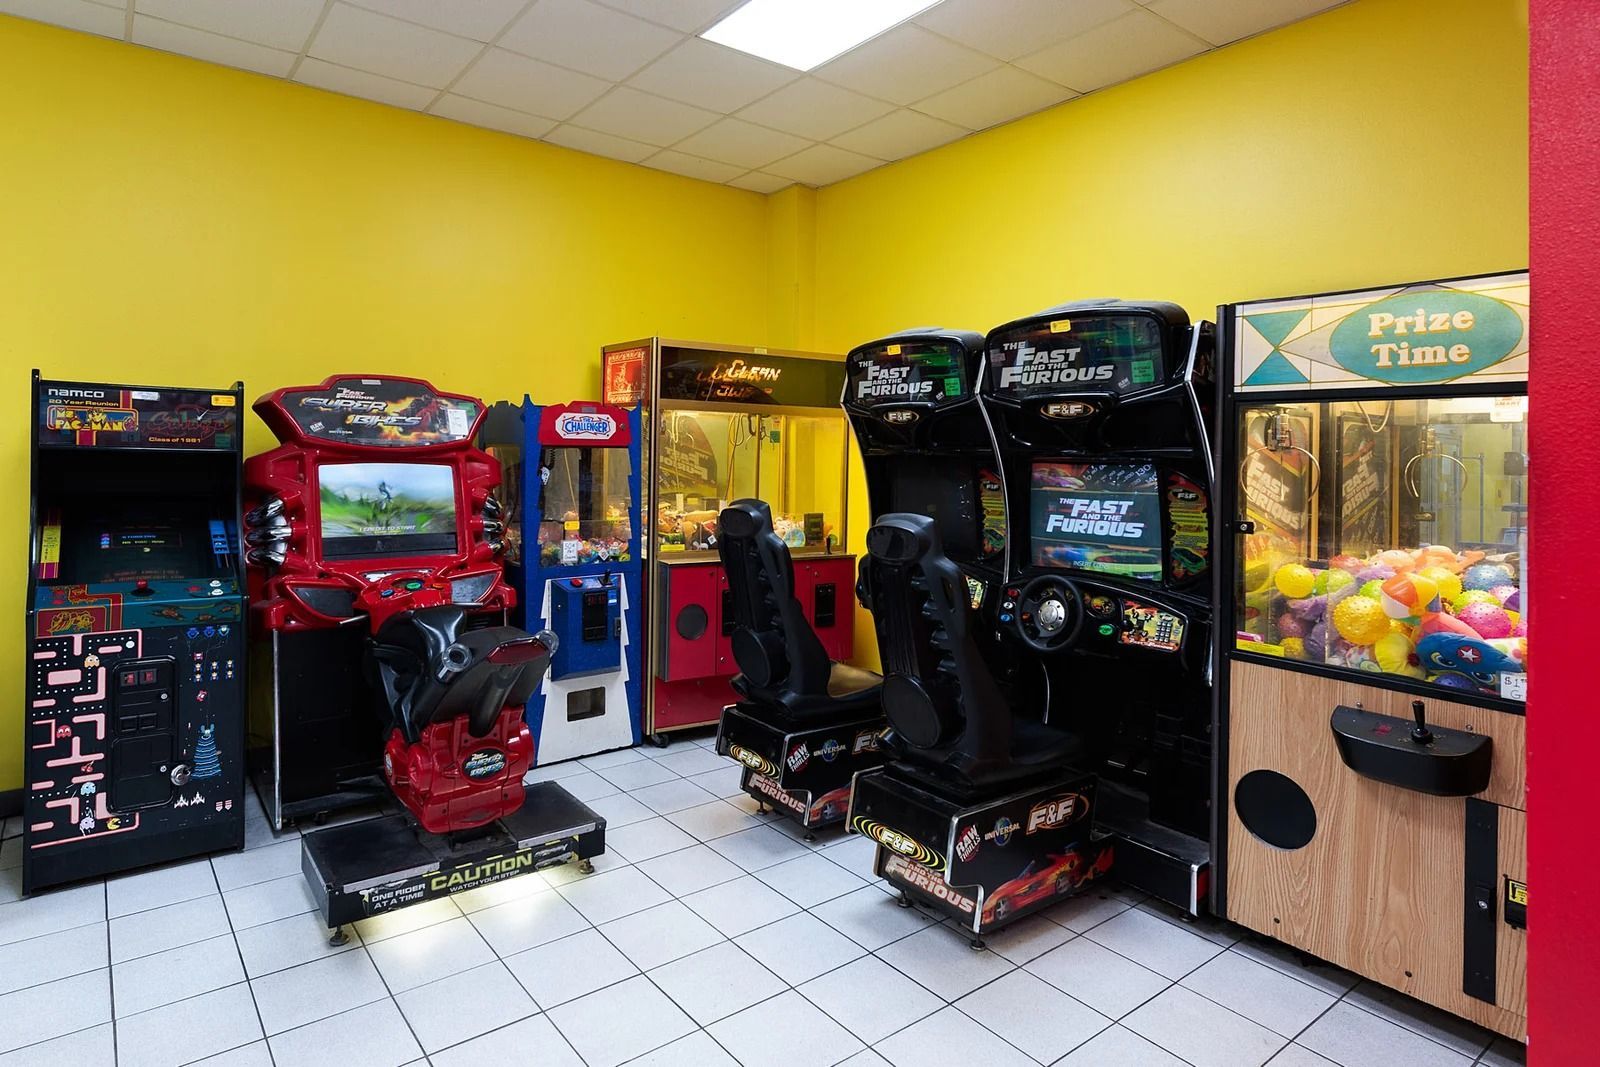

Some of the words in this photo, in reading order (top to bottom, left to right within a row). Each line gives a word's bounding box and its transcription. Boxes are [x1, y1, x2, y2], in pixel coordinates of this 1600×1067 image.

[1368, 308, 1475, 338] Prize
[1003, 341, 1026, 350] THE
[1370, 341, 1471, 369] Time
[859, 360, 874, 368] THE
[1016, 347, 1081, 365] FAST
[727, 359, 781, 381] CLEAN
[867, 365, 910, 380] FAST
[1024, 364, 1045, 372] AND
[1047, 361, 1069, 369] THE
[1000, 365, 1114, 388] FURIOUS
[48, 388, 105, 398] namco
[858, 381, 933, 398] FURIOUS
[303, 397, 388, 411] SUPER
[1049, 404, 1084, 415] F&F
[55, 419, 124, 431] PAC-MAN
[352, 415, 422, 427] BIKES
[888, 411, 912, 421] F&F
[565, 421, 608, 432] CHALLENGER
[1070, 499, 1134, 517] FAST
[1046, 514, 1144, 538] FURIOUS
[739, 750, 761, 767] F&F
[787, 744, 808, 767] RAW
[748, 772, 806, 813] FURIOUS
[1027, 798, 1075, 832] F&F
[955, 824, 979, 857] RAW
[984, 822, 1021, 841] UNIVERSAL
[880, 830, 915, 854] F&F
[431, 852, 533, 891] CAUTION
[450, 881, 479, 893] WATCH
[479, 874, 500, 886] YOUR
[501, 869, 520, 880] STEP
[371, 889, 393, 902] ONE
[395, 883, 426, 896] RIDER
[885, 854, 975, 913] FURIOUS
[374, 901, 388, 910] AT
[390, 899, 398, 907] A
[399, 890, 424, 902] TIME
